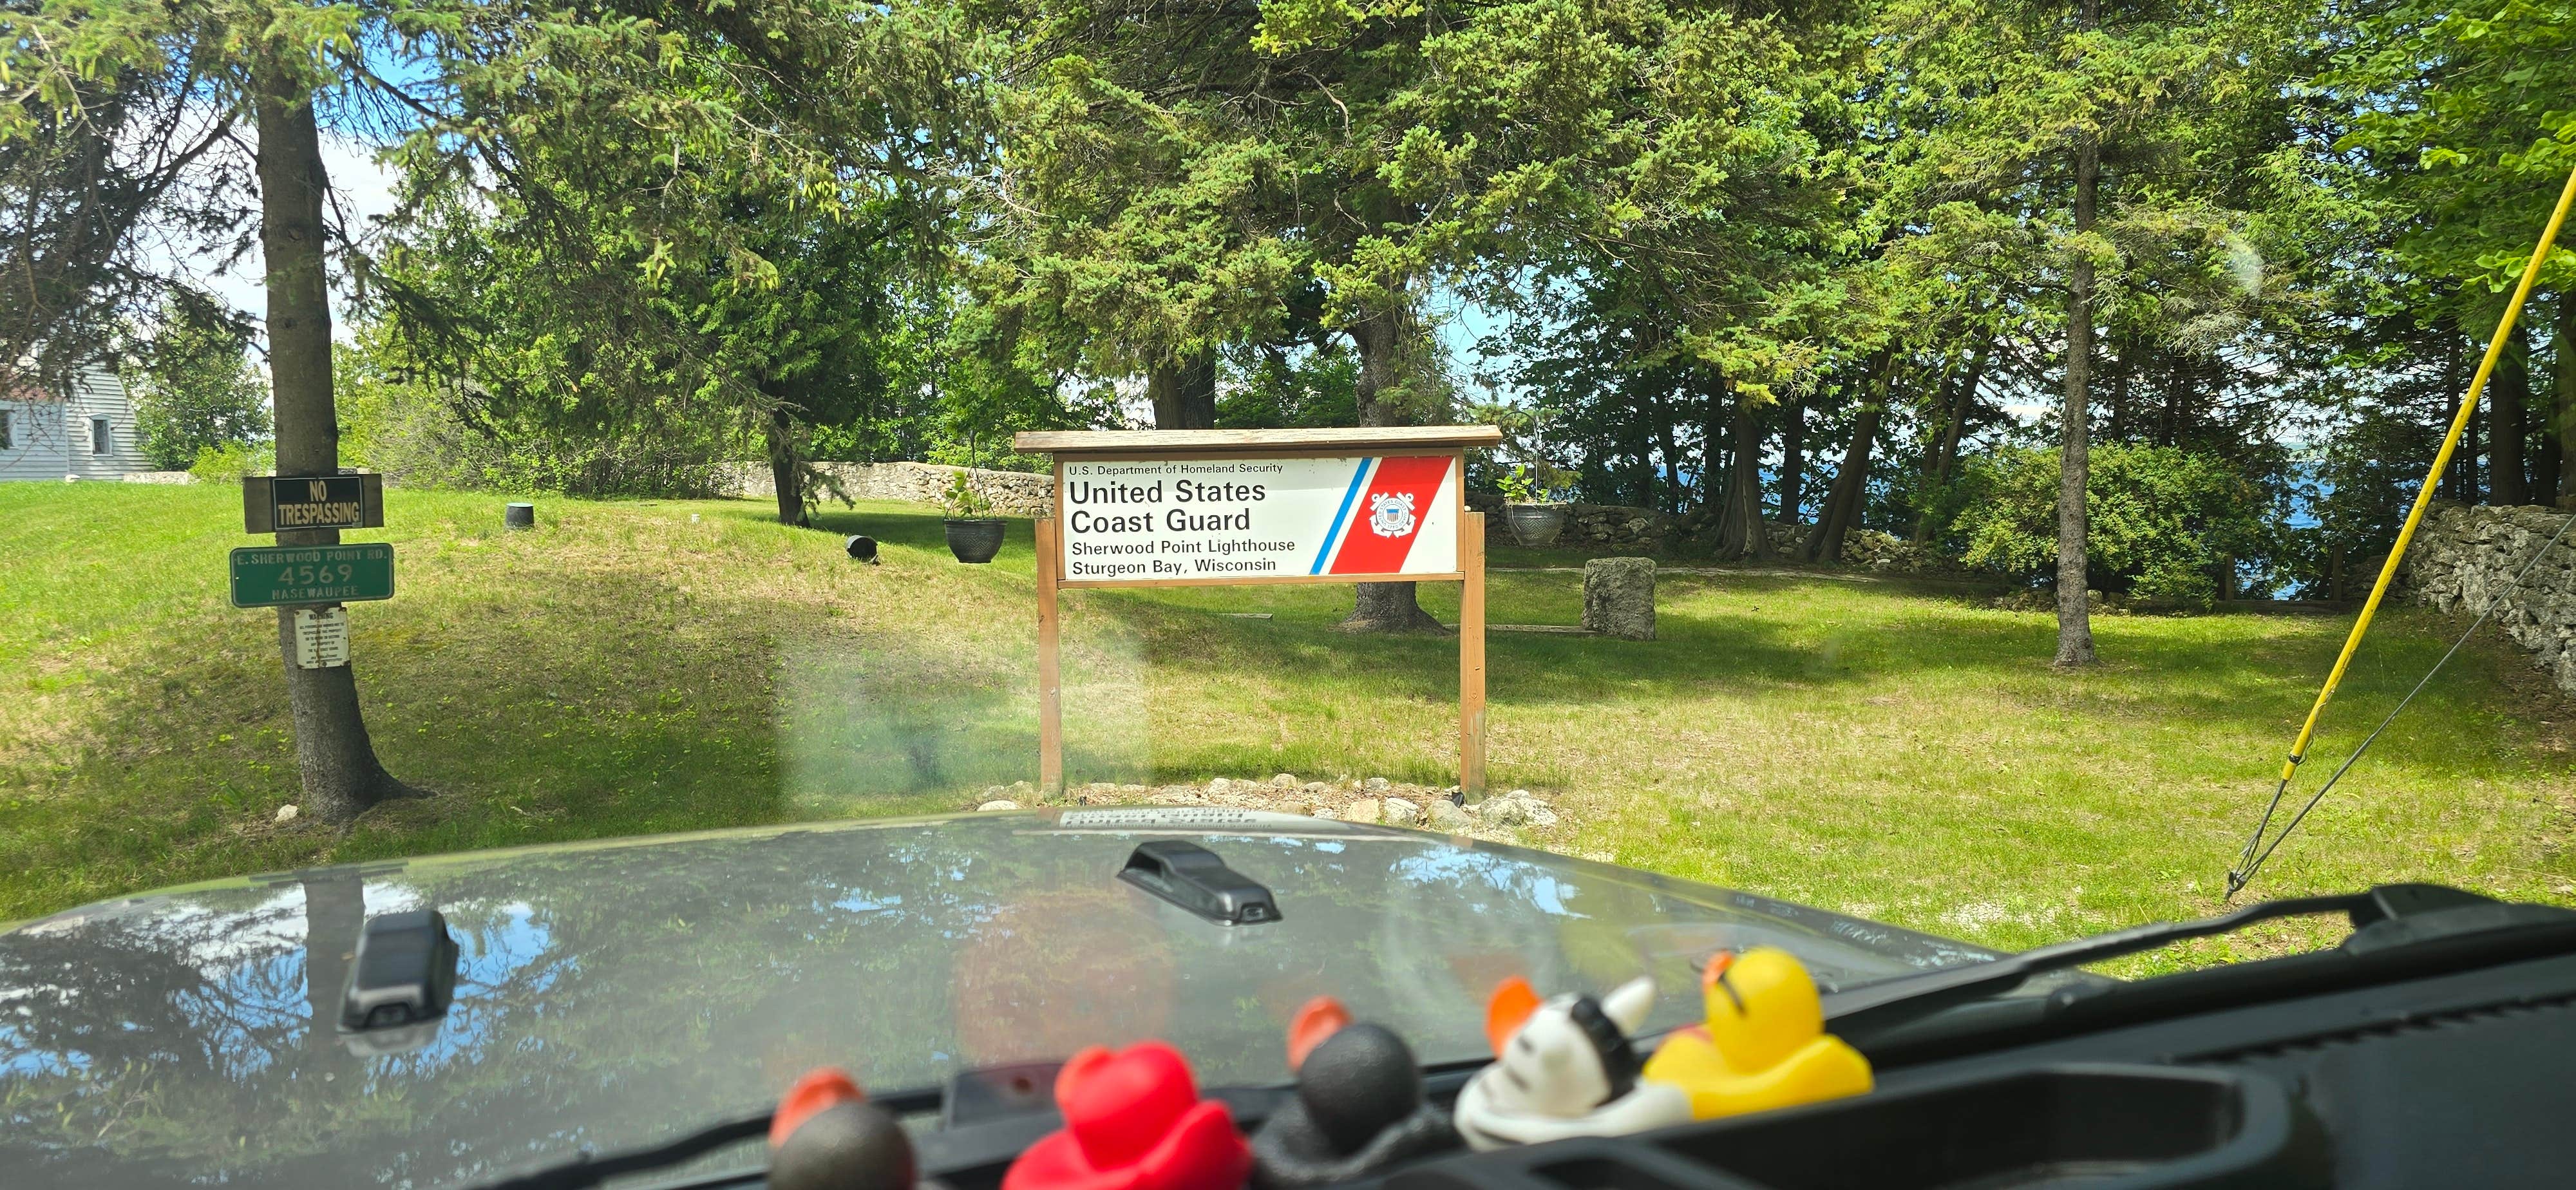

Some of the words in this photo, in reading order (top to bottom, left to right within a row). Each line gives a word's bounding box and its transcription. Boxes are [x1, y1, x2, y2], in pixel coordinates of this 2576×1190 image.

[1069, 466, 1093, 475] U.S.
[1097, 464, 1162, 477] Department
[1166, 463, 1177, 474] of
[1180, 462, 1235, 473] Homeland
[1239, 462, 1283, 475] Security
[309, 480, 327, 502] NO
[1070, 480, 1162, 504] United
[1175, 479, 1265, 503] States
[278, 502, 360, 525] TRESPASSING
[1071, 510, 1154, 534] Coast
[1166, 507, 1250, 532] Guard
[237, 556, 249, 565] E.
[251, 551, 321, 565] SHERWOOD
[327, 550, 361, 561] POINT
[368, 549, 387, 560] RD.
[1072, 541, 1154, 556] Sherwood
[1161, 540, 1202, 554] Point
[1208, 538, 1295, 555] Lighthouse
[278, 565, 353, 585] 4569
[1072, 562, 1146, 577] Sturgeon
[1153, 560, 1188, 575] Bay,
[1194, 556, 1276, 572] Wisconsin
[272, 586, 359, 600] NASEWAUPEE
